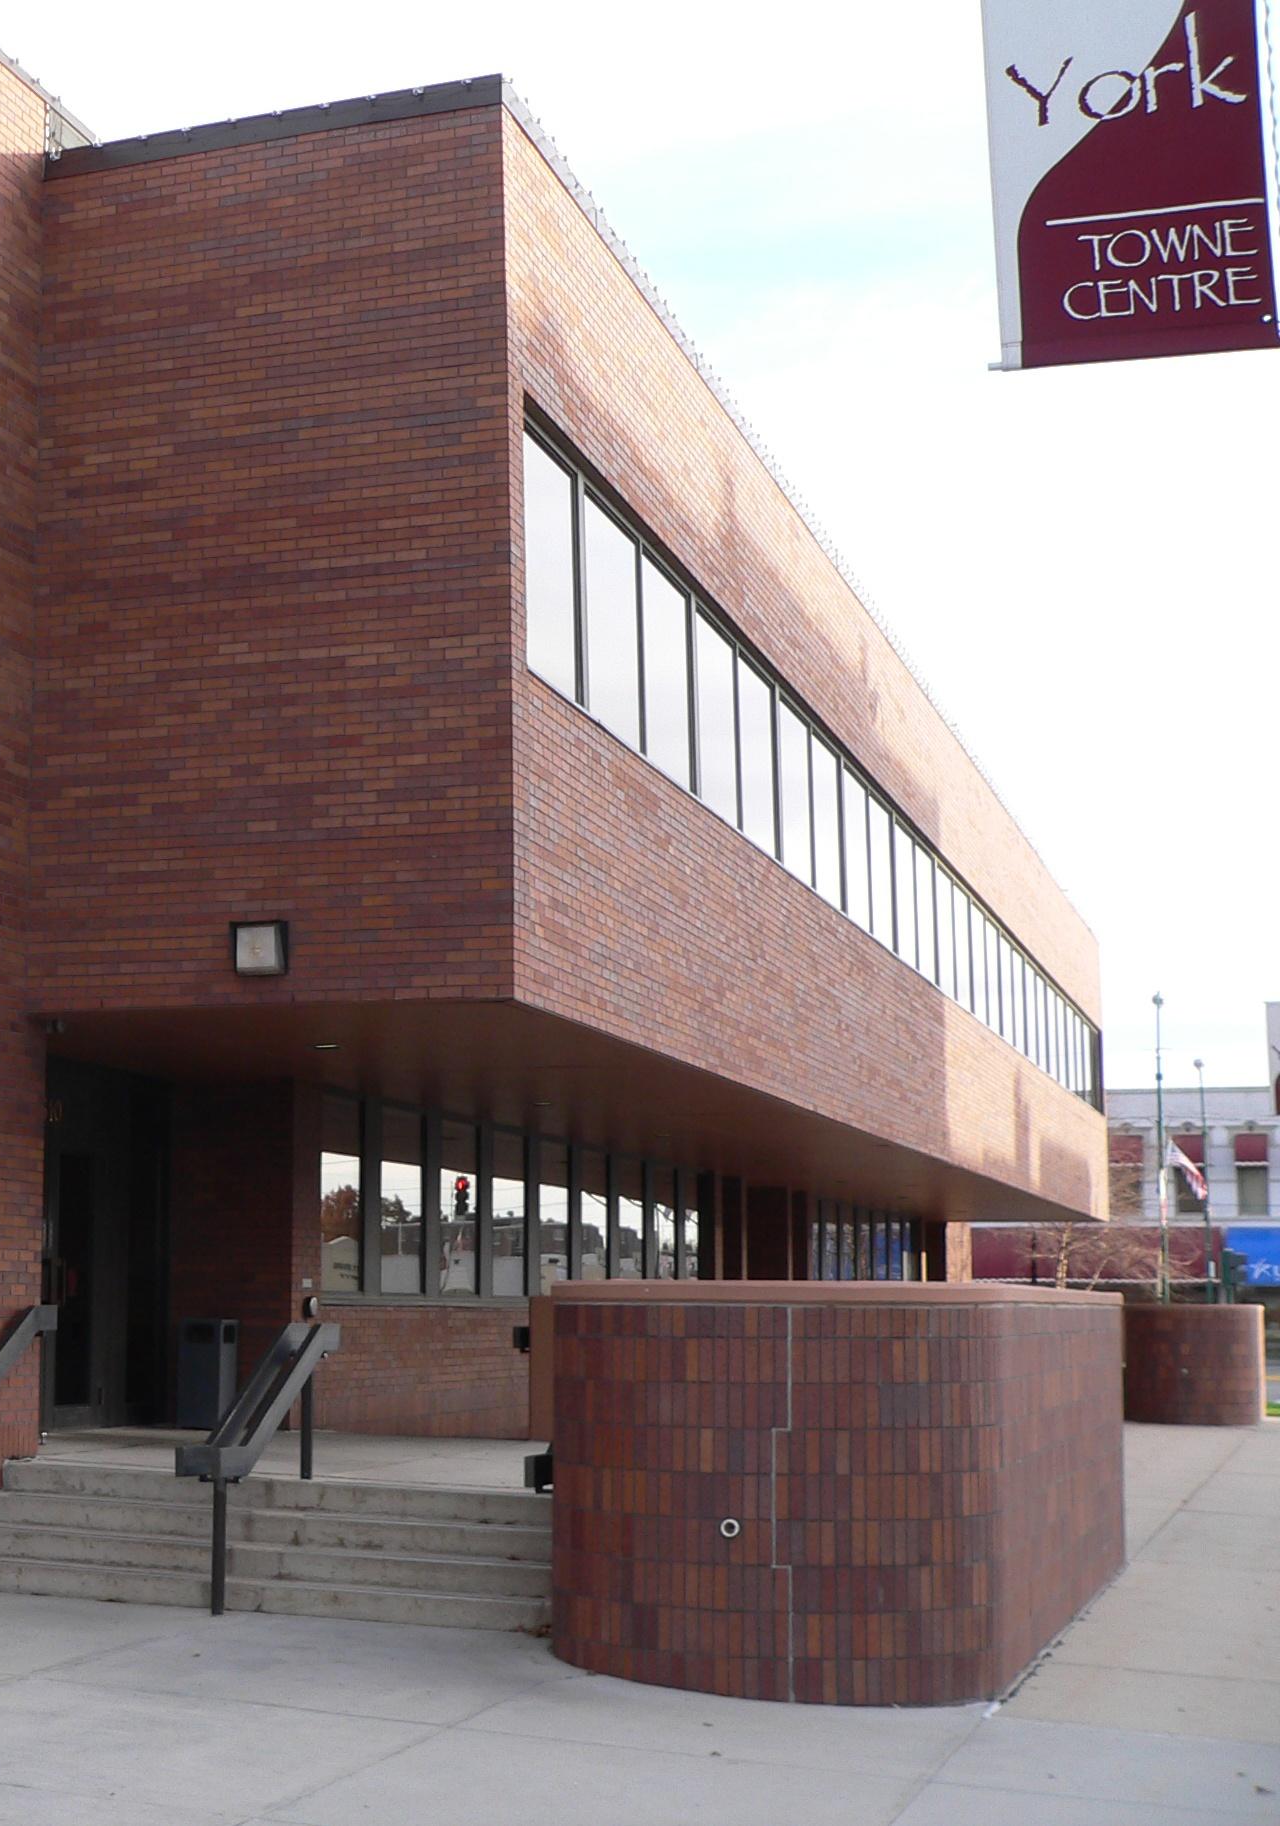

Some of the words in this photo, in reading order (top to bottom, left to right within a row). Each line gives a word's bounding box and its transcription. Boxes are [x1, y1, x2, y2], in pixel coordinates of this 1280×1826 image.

[1005, 11, 1248, 127] York
[1077, 218, 1259, 271] TOWNE
[1062, 266, 1262, 320] CENTRE
